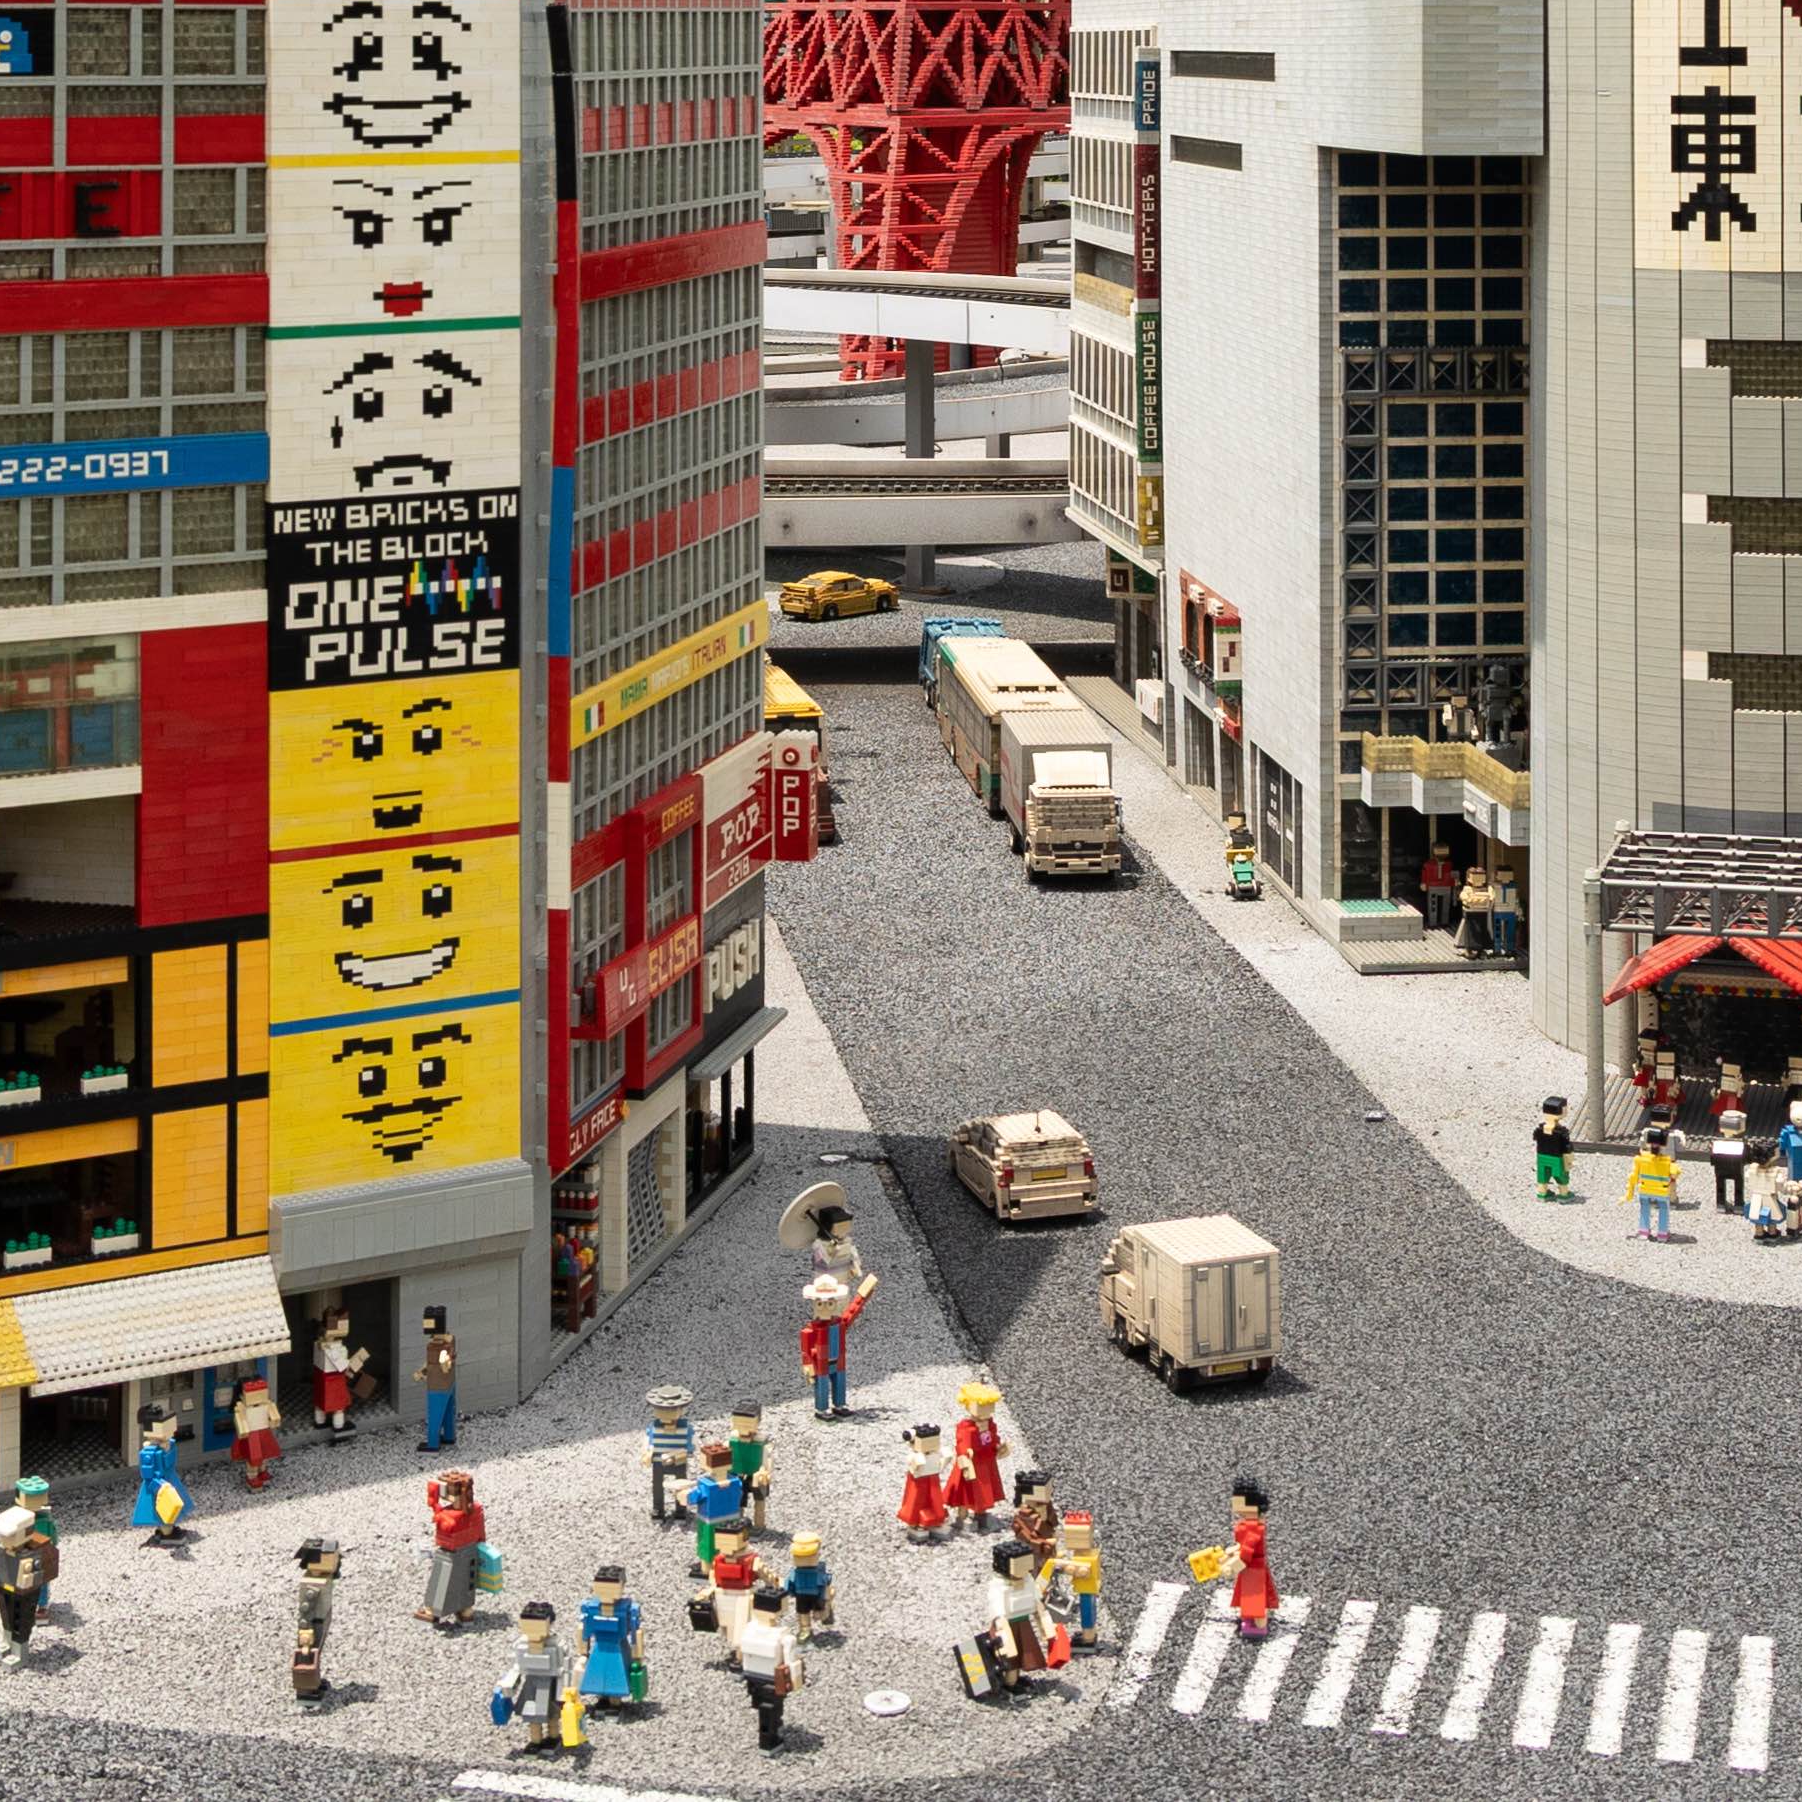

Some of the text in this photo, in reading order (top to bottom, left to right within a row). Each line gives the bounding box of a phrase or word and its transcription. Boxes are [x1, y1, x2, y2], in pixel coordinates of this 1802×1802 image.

[1142, 70, 1155, 125] PRIDE
[1143, 320, 1158, 450] COFFEE HOUSE
[273, 494, 518, 535] NEW BRICKS ON
[305, 529, 489, 567] THE BLOCK
[285, 575, 404, 630] ONE
[305, 618, 506, 681] PULSE
[661, 794, 695, 834] COFFEE
[720, 802, 760, 860] POP
[782, 775, 800, 837] POP
[648, 919, 698, 993] ELISA
[703, 917, 760, 1014] PUSH
[590, 1099, 616, 1138] FACE
